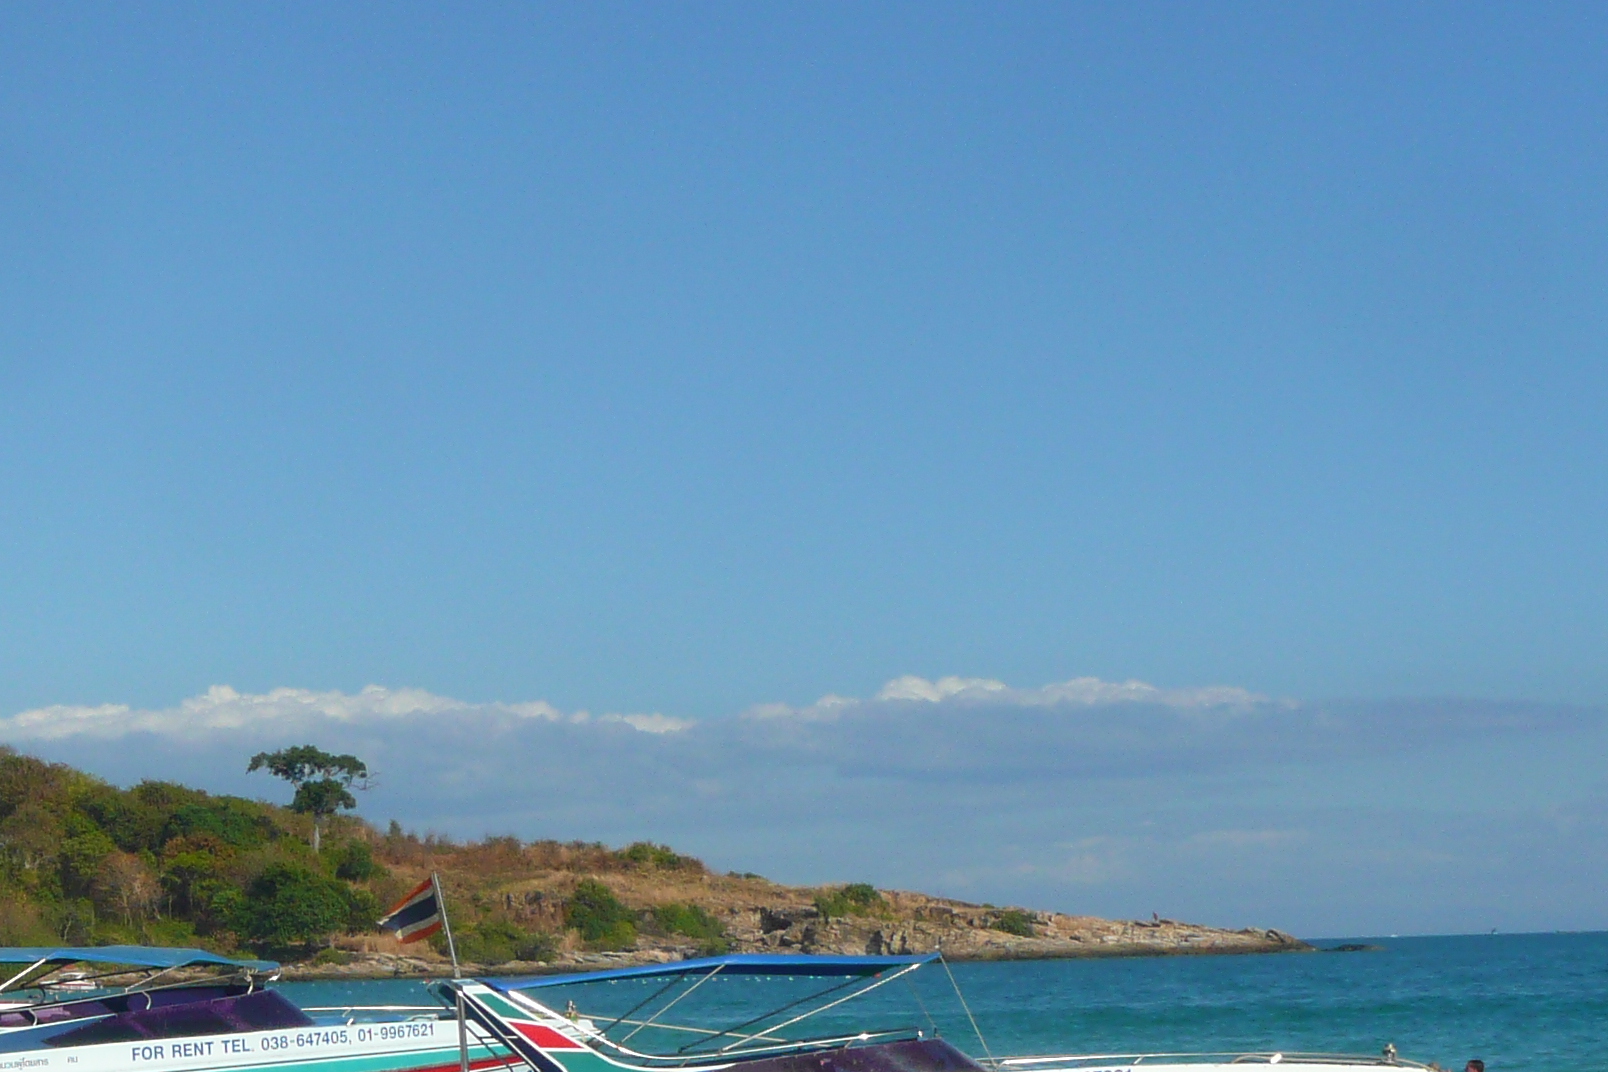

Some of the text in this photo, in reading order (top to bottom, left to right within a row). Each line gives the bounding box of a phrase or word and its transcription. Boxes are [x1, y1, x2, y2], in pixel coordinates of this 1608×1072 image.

[132, 1046, 164, 1060] FOR
[172, 1042, 213, 1058] RENT
[358, 1023, 434, 1042] 01-9967621
